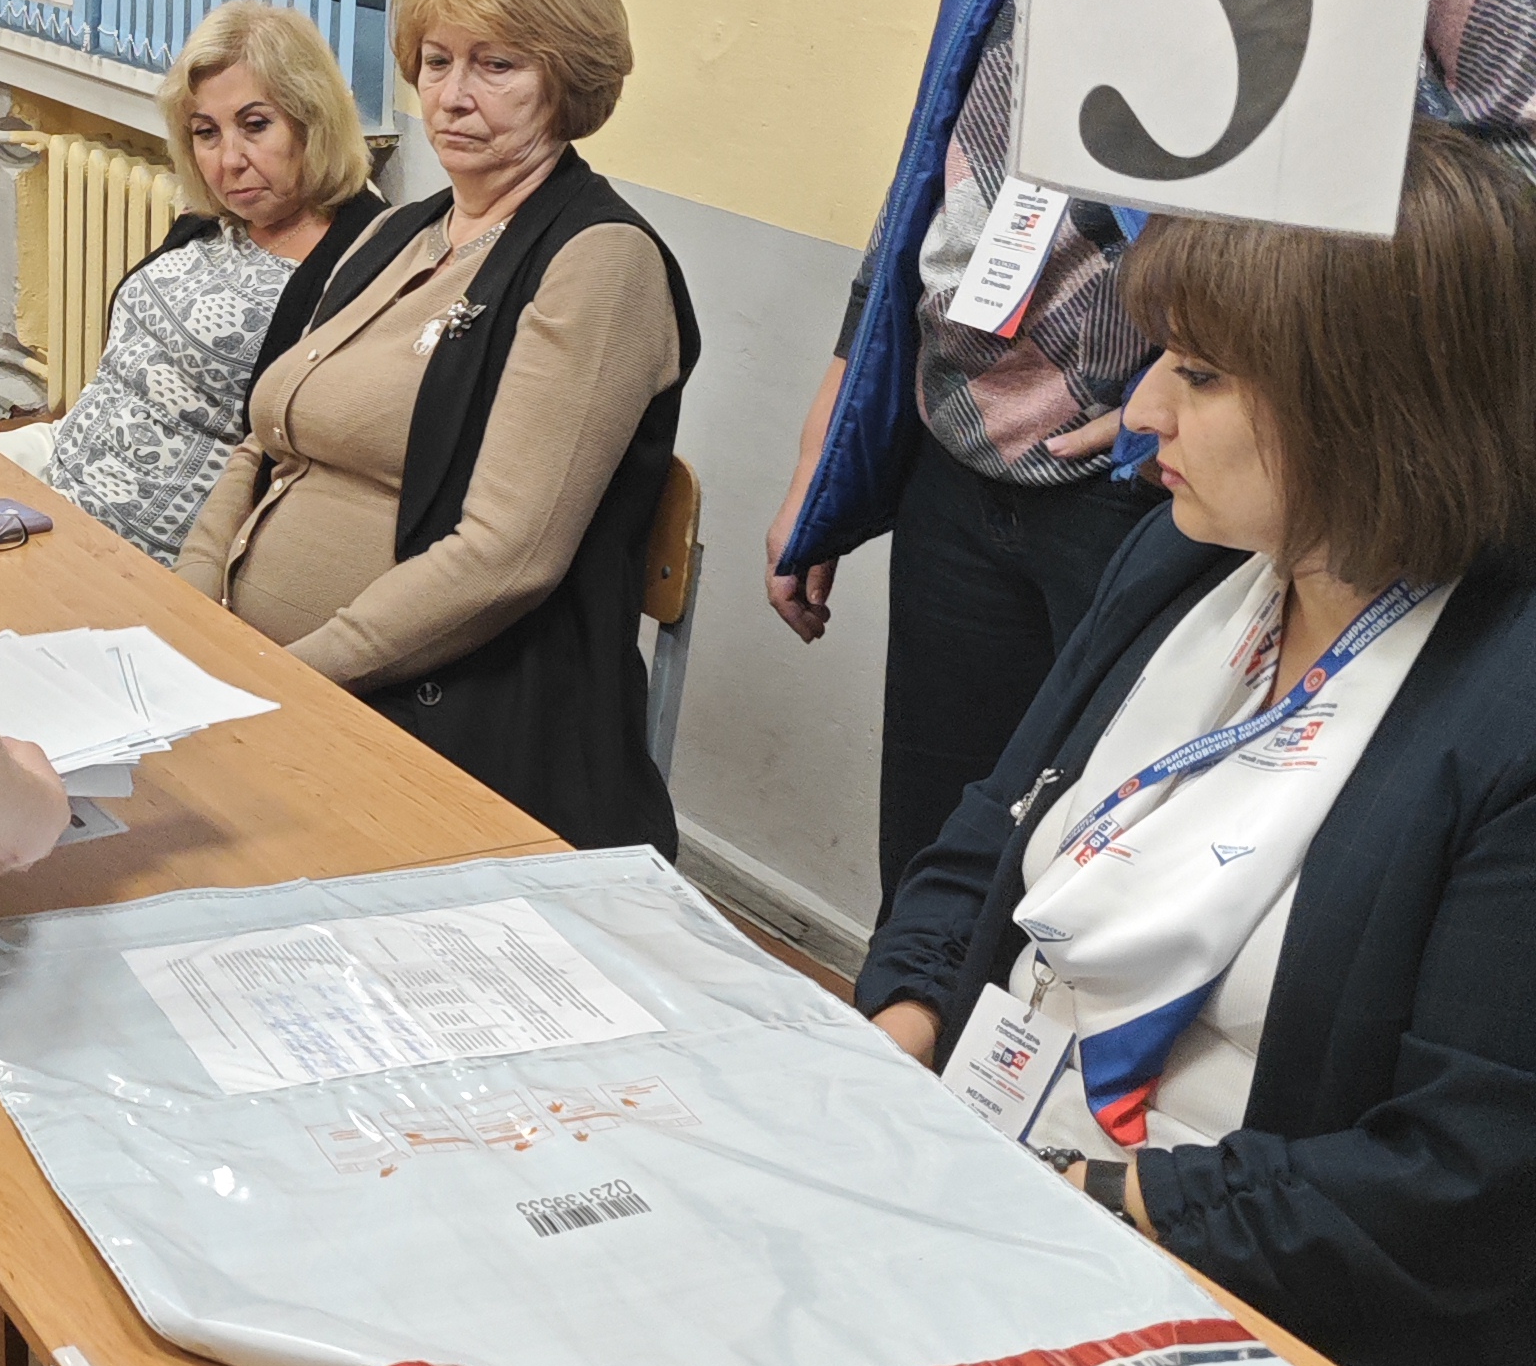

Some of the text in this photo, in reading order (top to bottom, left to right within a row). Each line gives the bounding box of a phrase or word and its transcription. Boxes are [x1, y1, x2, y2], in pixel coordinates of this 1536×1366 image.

[1331, 586, 1404, 658] ИЗБИРАТЕЛЬНАЯ
[1348, 597, 1413, 656] МОСКОВСКОЙ
[1153, 727, 1237, 773] ИЗБИРАТЕЛЬНАЯ
[1167, 736, 1237, 774] МОСКОВСКОЙ
[1089, 833, 1106, 848] 19
[1097, 819, 1113, 832] 18
[516, 1178, 633, 1217] 023139533
